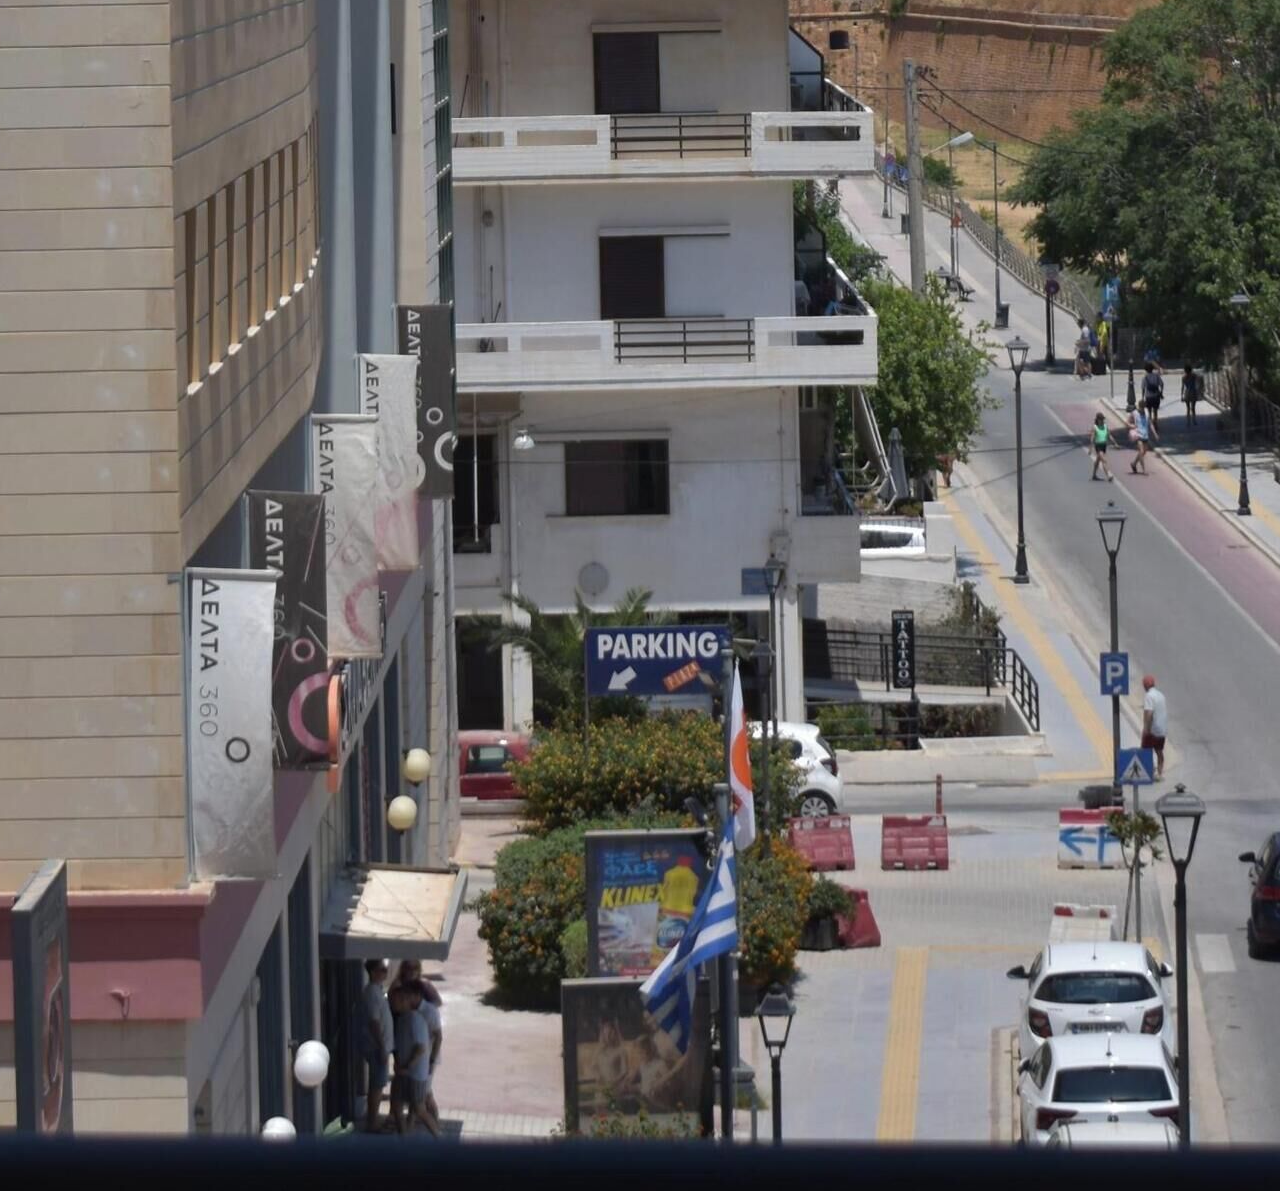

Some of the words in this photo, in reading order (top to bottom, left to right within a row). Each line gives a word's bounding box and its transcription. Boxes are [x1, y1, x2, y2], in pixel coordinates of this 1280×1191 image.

[407, 309, 421, 362] ΔΕΛΤ
[366, 361, 379, 415] ΔΕΛΤ
[200, 578, 220, 671] ΔΕΛΤΑ
[597, 630, 719, 660] PARKING
[897, 620, 909, 678] TATTOO
[1106, 661, 1124, 685] P
[199, 685, 218, 737] 360
